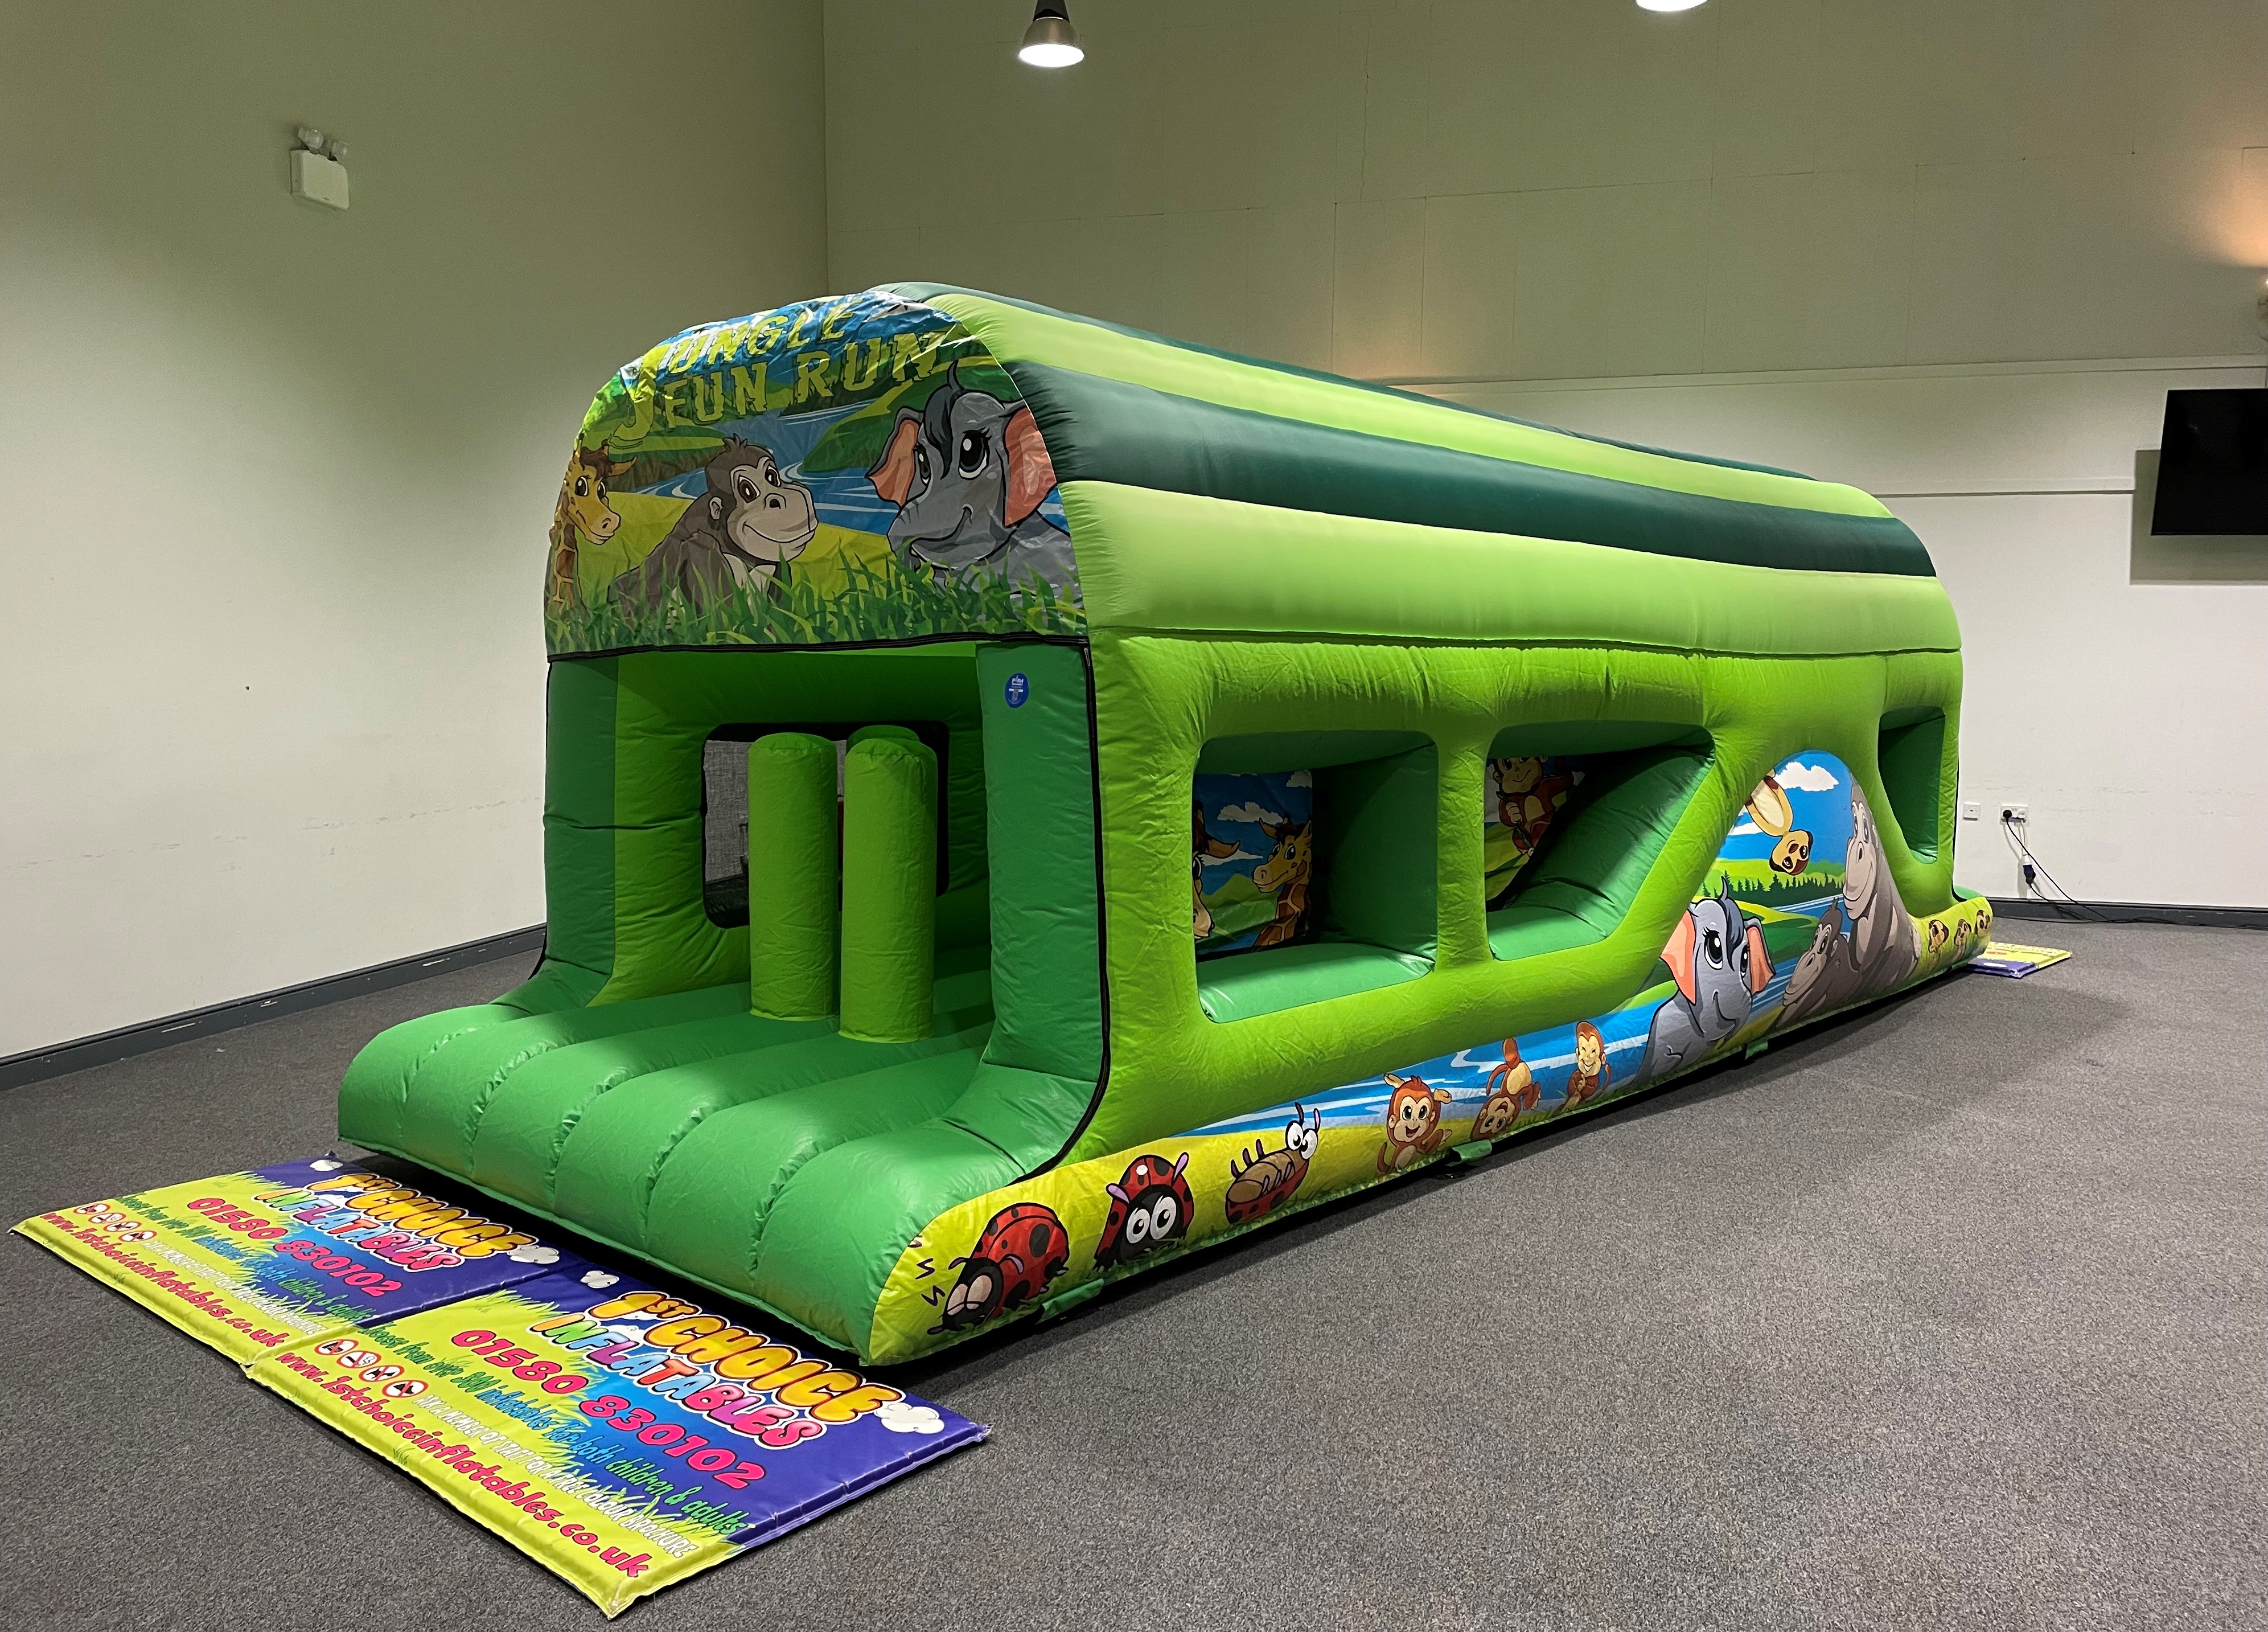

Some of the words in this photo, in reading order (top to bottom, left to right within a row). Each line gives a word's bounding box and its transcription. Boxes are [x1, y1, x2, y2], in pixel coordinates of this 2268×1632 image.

[614, 297, 864, 440] JUNGLE
[663, 362, 768, 429] FUN
[796, 331, 946, 404] RUN
[256, 1188, 462, 1270] INFLATABLES
[346, 1188, 538, 1257] CHOICE
[187, 1198, 288, 1240] 01580
[273, 1240, 403, 1297] 830102
[255, 1263, 298, 1282] both
[277, 1277, 326, 1301] children
[314, 1294, 349, 1306] &
[325, 1303, 377, 1322] adults
[393, 1342, 435, 1365] from
[531, 1314, 823, 1448] INFLATABLES
[644, 1315, 905, 1421] CHOICE
[412, 1394, 447, 1408] ASK
[429, 1405, 453, 1415] A
[451, 1330, 589, 1394] 01580
[578, 1395, 767, 1490] 830102
[474, 1384, 558, 1430] inflatables
[441, 1409, 492, 1438] MEMBER
[479, 1431, 509, 1445] OF
[490, 1438, 540, 1461] STAFF
[569, 1436, 627, 1464] both
[516, 1455, 554, 1475] FOR
[538, 1468, 563, 1480] A
[604, 1457, 675, 1496] children
[547, 1473, 591, 1495] FREE
[663, 1486, 704, 1505] &
[575, 1488, 638, 1522] COLOUR
[680, 1502, 750, 1535] adults
[618, 1512, 699, 1559] BROCHURE
